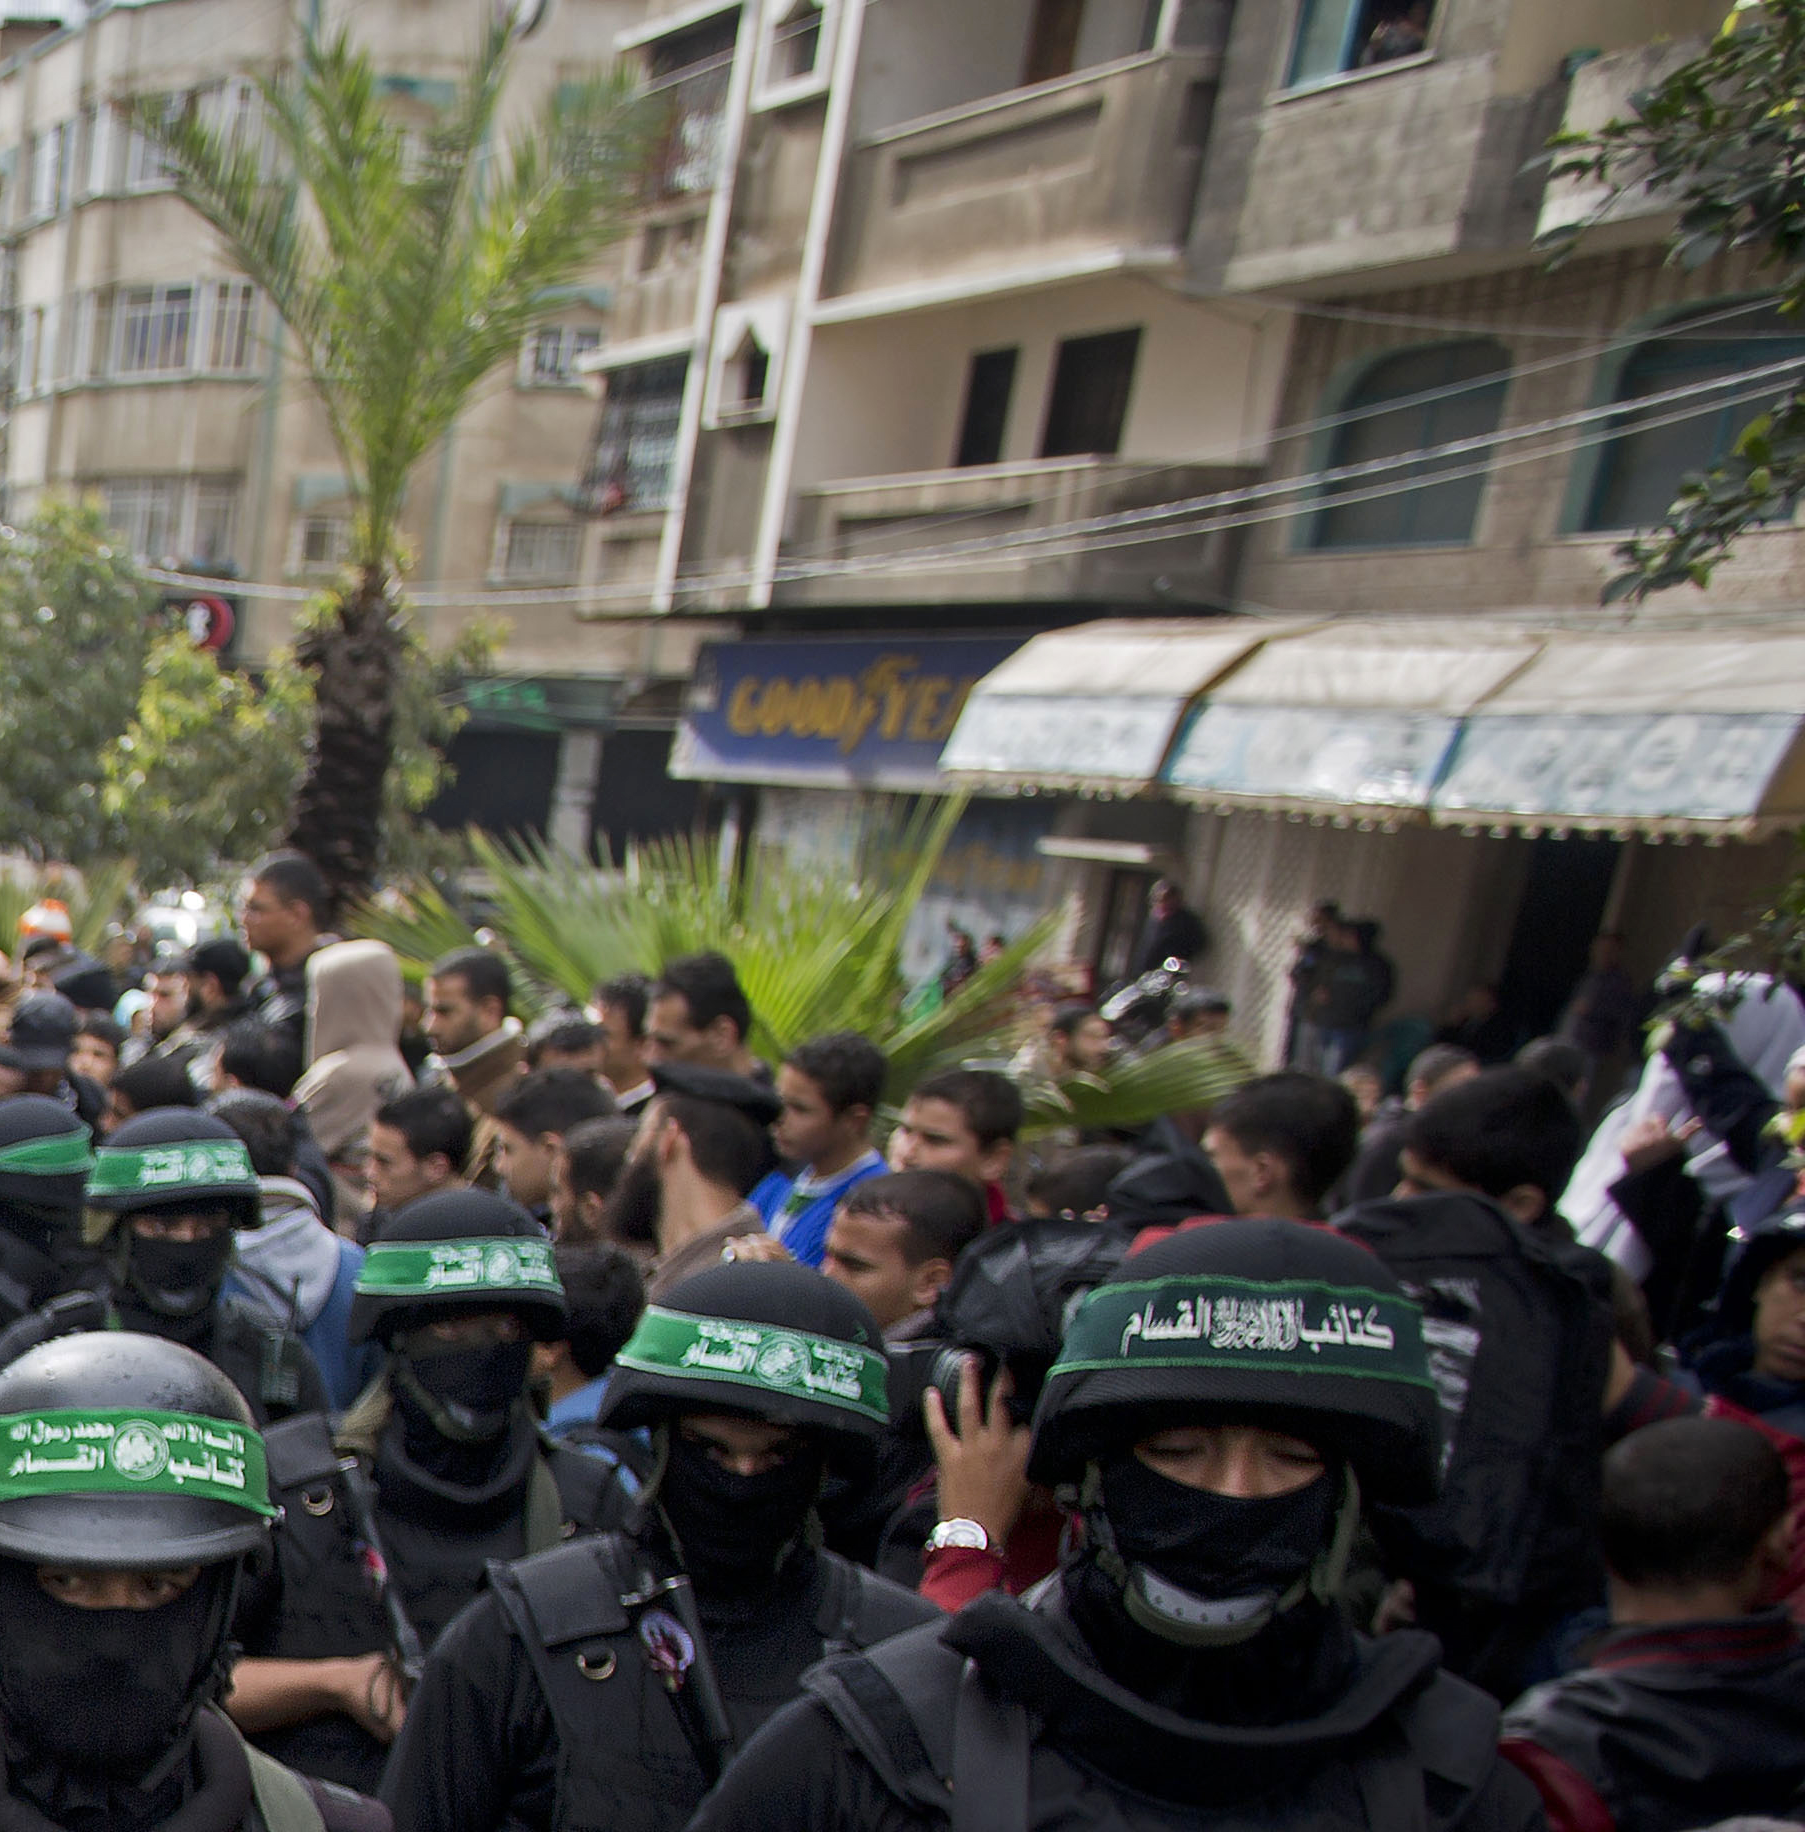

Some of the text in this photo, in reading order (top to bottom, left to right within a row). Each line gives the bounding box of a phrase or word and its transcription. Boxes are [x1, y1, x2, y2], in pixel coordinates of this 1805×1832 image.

[727, 655, 972, 755] GOODYE
[1119, 1295, 1212, 1357] القسام
[1300, 1305, 1394, 1353] كتائب
[8, 1443, 105, 1478] القسام
